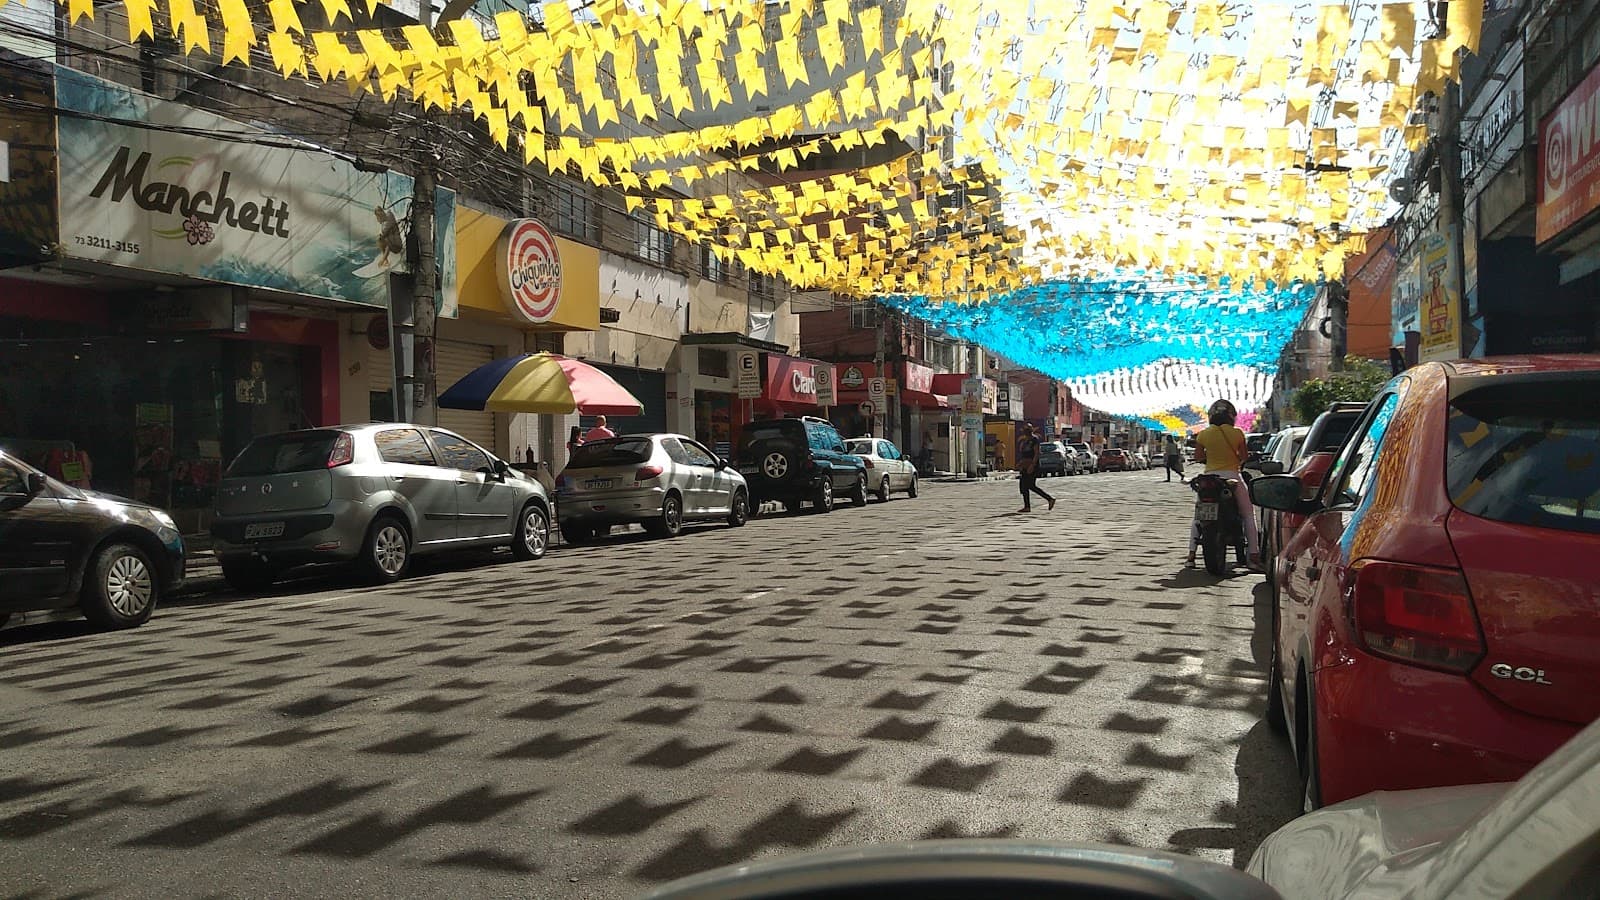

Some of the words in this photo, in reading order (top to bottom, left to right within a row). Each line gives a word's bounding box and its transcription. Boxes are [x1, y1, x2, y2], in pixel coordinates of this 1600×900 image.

[90, 146, 290, 239] Manchett
[74, 236, 85, 245] 73
[87, 236, 140, 254] 3211-3155
[511, 257, 560, 290] Chiquinho
[743, 357, 753, 369] E
[793, 370, 817, 394] Claro
[873, 382, 881, 392] E
[1491, 663, 1552, 685] GOL
